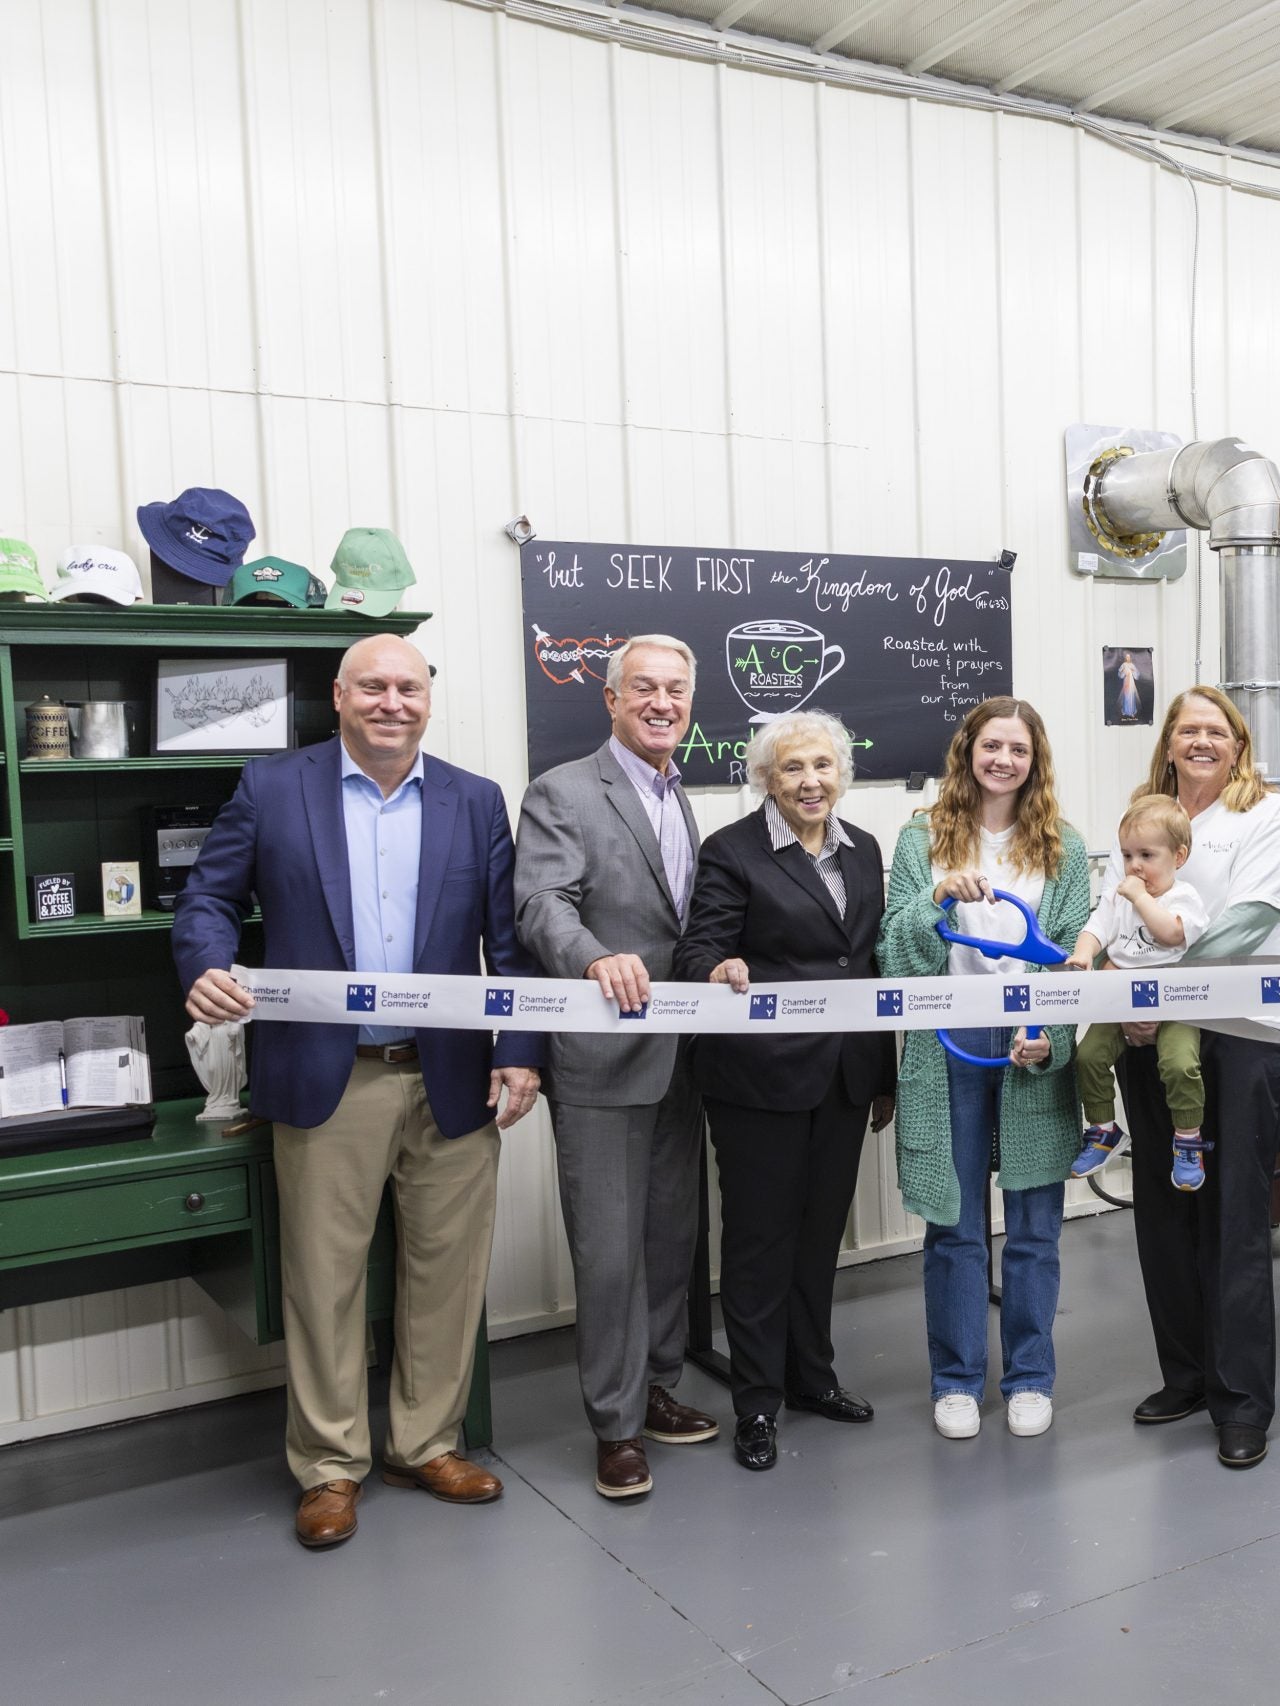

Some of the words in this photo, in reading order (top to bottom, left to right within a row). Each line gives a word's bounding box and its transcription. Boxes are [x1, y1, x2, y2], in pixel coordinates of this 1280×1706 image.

[606, 553, 672, 592] SEEK
[696, 557, 755, 594] FIRST
[770, 571, 798, 583] the
[796, 558, 898, 612] Kingdom
[909, 575, 931, 613] of
[883, 636, 948, 652] Roasted
[953, 639, 988, 653] with
[741, 644, 765, 674] A
[782, 645, 804, 674] C
[911, 654, 940, 669] Love
[956, 659, 1003, 677] prayers
[750, 671, 804, 687] ROASTERS
[940, 674, 970, 690] from
[921, 695, 944, 704] our
[944, 709, 957, 721] to
[39, 877, 62, 889] FUELED
[42, 892, 70, 906] COFFEE
[282, 987, 291, 995] of
[1035, 989, 1070, 998] Chamber
[1071, 988, 1080, 997] of
[1163, 984, 1198, 993] Chamber
[1200, 984, 1210, 993] of
[253, 996, 289, 1004] mmerce
[381, 991, 420, 1001] Chamber
[421, 991, 431, 1000] of
[518, 995, 557, 1005] Chamber
[558, 996, 568, 1005] of
[908, 994, 943, 1002] Chamber
[944, 993, 953, 1002] of
[1164, 993, 1209, 1002] Commerce
[381, 1000, 429, 1009] Commerce
[652, 999, 690, 1007] Chamber
[782, 998, 817, 1007] Chamber
[818, 997, 827, 1006] of
[908, 1002, 952, 1011] Commerce
[1035, 998, 1079, 1006] Commerce
[518, 1004, 565, 1013] Commerce
[652, 1007, 697, 1015] Commerce
[781, 1006, 825, 1015] Commerce
